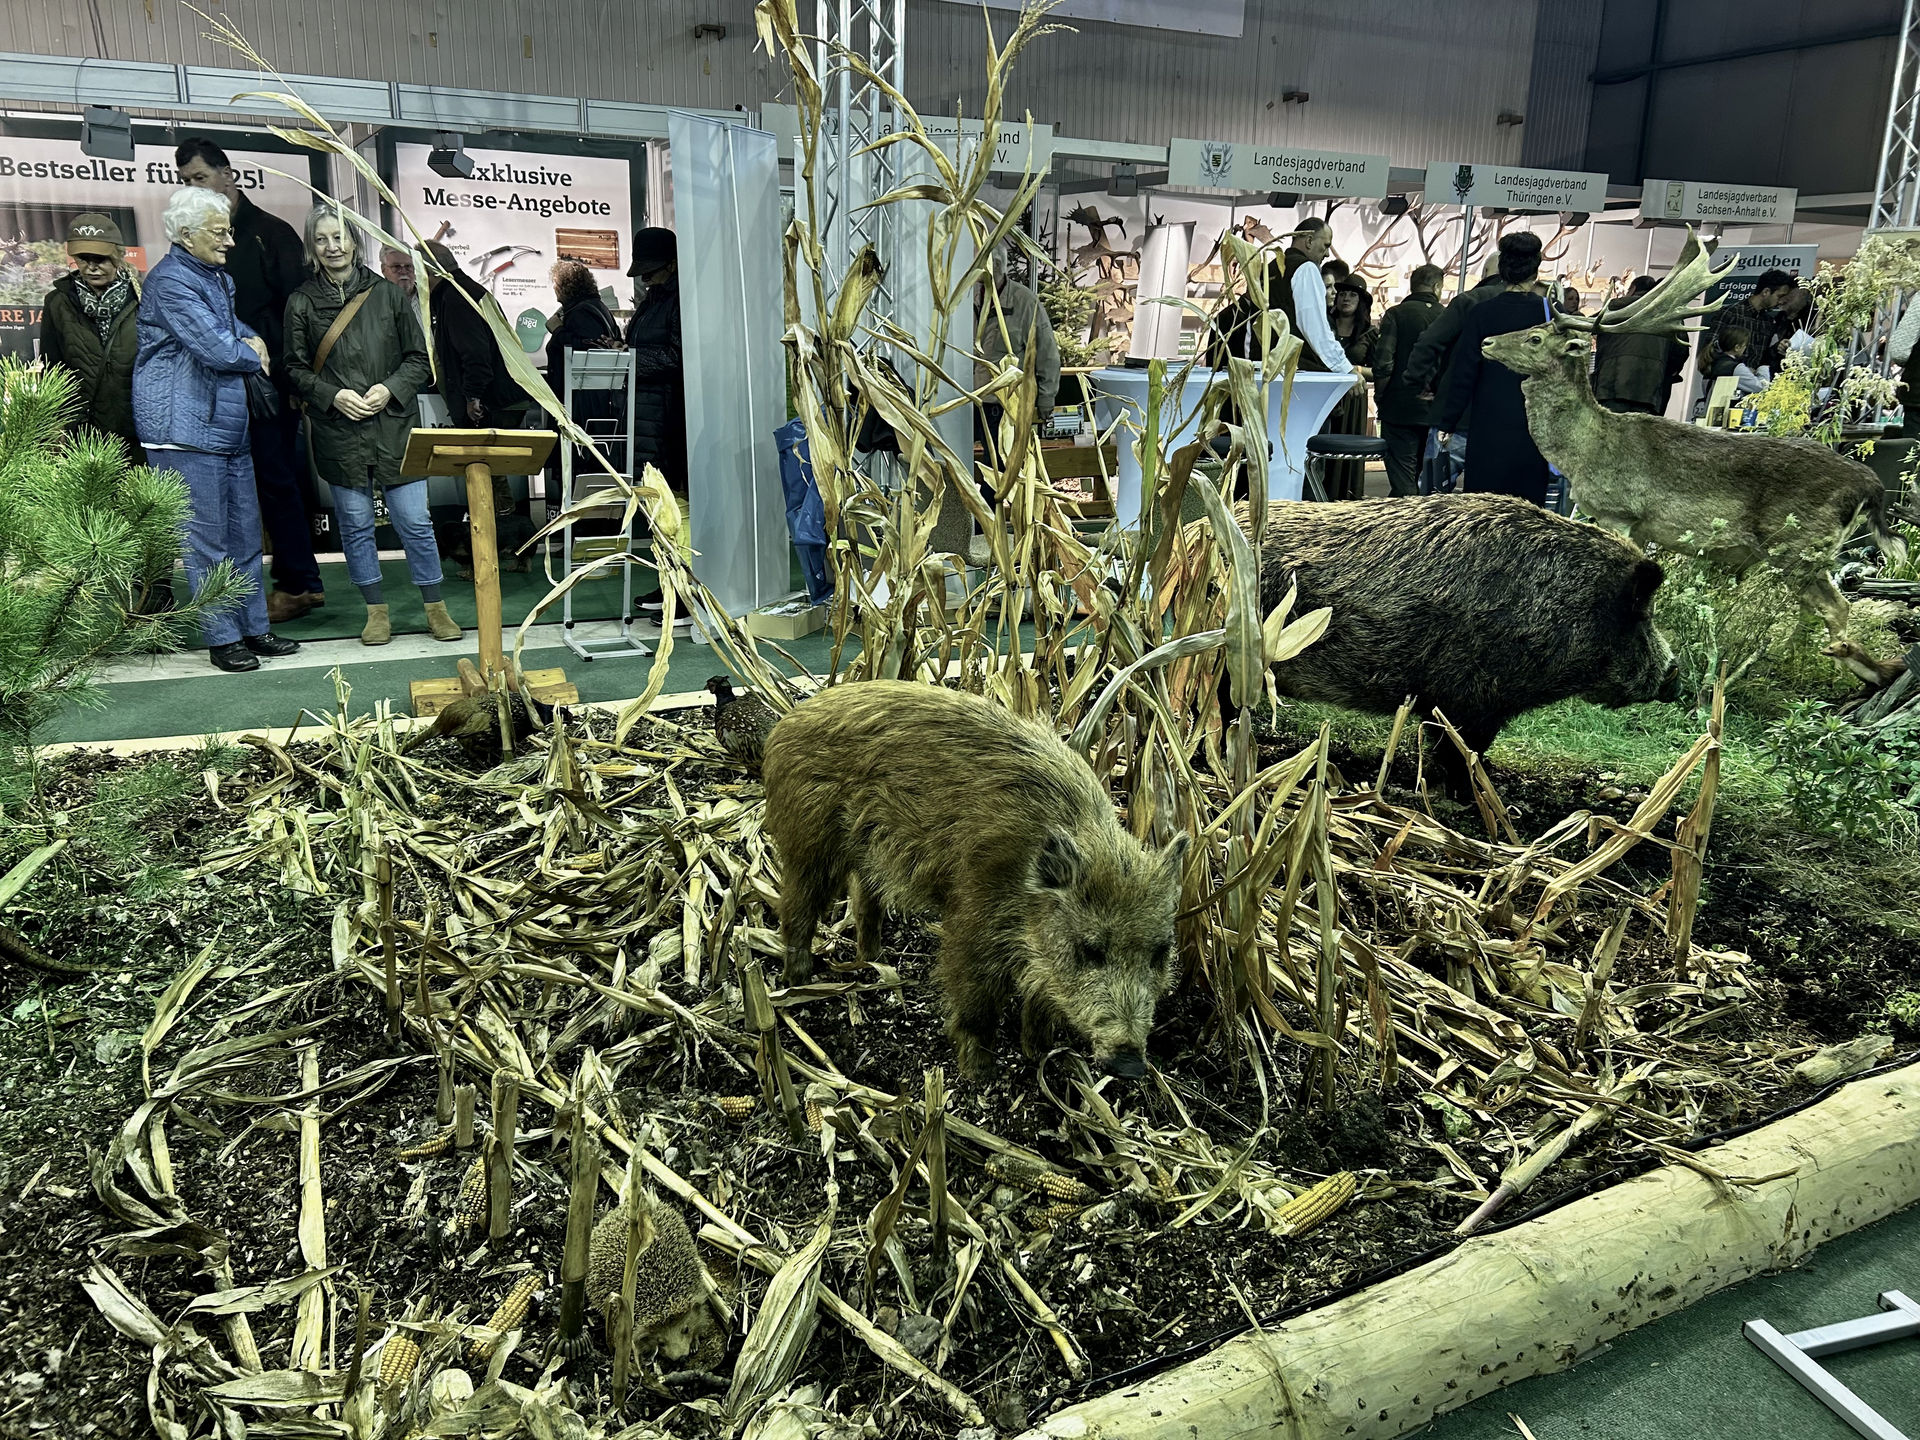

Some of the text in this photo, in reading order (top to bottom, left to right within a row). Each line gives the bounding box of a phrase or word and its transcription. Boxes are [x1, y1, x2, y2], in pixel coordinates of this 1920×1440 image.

[0, 156, 136, 182] Bestseller
[1254, 152, 1366, 173] Landesjagdverband
[464, 163, 572, 187] xklusive
[1272, 172, 1345, 189] Sachsen e.V.
[1495, 173, 1587, 190] Landesjagdverband
[423, 187, 611, 218] Messe-Angebote
[1507, 190, 1573, 206] Thüringen e.V.
[1698, 188, 1778, 204] Landesjagdverband
[1696, 203, 1777, 218] Sachsen-Anhalt e.V.
[1723, 255, 1801, 271] gdleben
[1719, 282, 1757, 291] Erfolgre
